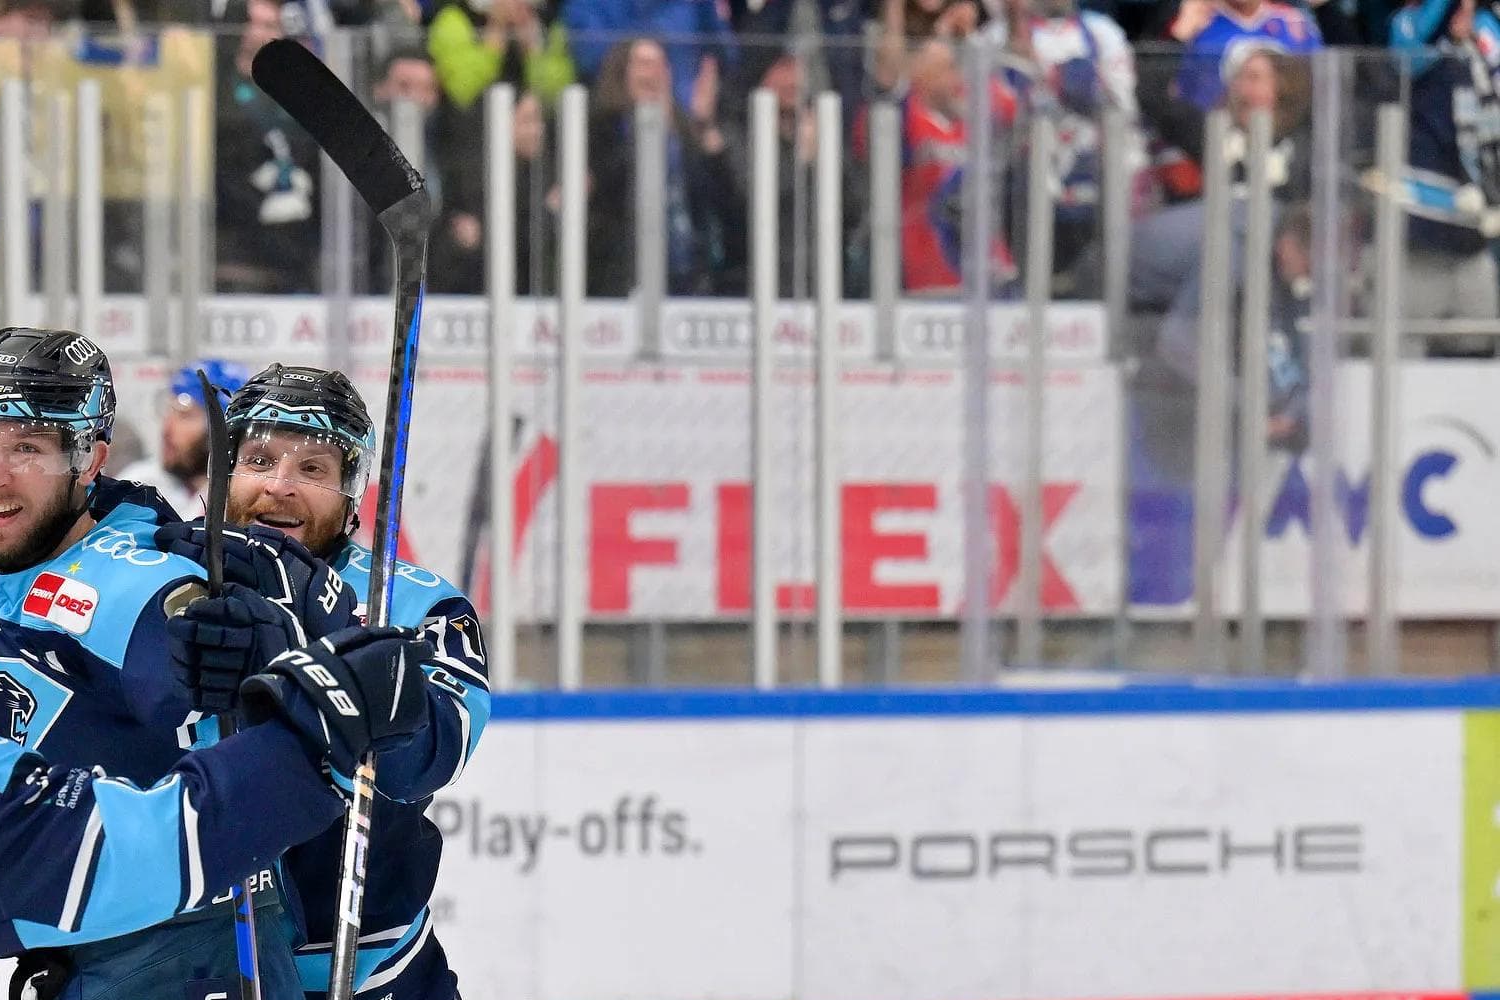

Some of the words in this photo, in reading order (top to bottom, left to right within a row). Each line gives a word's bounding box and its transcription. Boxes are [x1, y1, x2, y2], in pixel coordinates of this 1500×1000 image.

[587, 482, 1084, 611] FLEX
[433, 795, 705, 875] Play-offs.
[829, 824, 1363, 882] PORSCHE
